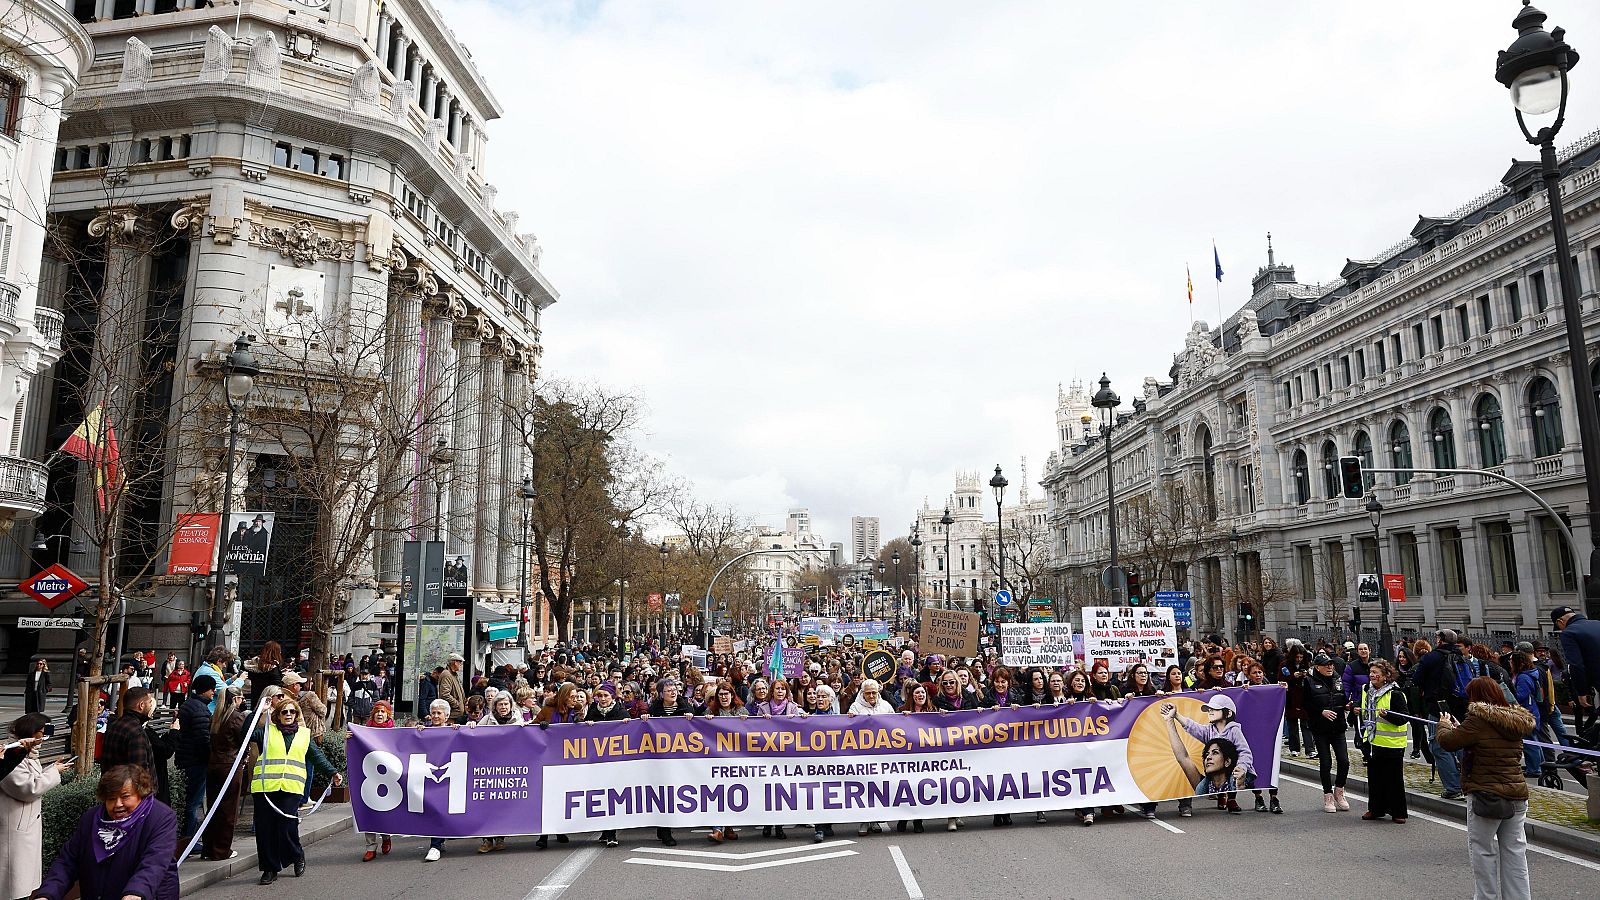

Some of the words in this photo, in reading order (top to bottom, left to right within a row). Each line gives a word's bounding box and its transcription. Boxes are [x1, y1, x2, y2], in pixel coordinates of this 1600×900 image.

[36, 581, 66, 591] Metro
[939, 612, 952, 620] QUE
[21, 619, 42, 627] Banco
[44, 619, 53, 627] de
[55, 620, 80, 628] España
[931, 619, 967, 631] EPSTEIN
[1096, 620, 1108, 629] LA
[1139, 617, 1173, 629] MUNDIAL
[1001, 626, 1031, 636] HOMBRES
[1044, 626, 1069, 636] MANDO
[1089, 630, 1110, 638] VIOLA
[1139, 629, 1165, 637] ASESINA
[935, 636, 965, 650] PORNO
[1100, 639, 1130, 647] MUJERES
[1138, 638, 1166, 647] MENORES
[1003, 645, 1032, 654] PUTEROS
[1040, 645, 1073, 654] ACOSANDO
[1018, 655, 1057, 665] VIOLANDO
[563, 738, 587, 759] NI
[593, 732, 711, 757] VELADAS,
[716, 732, 740, 752] NI
[746, 728, 913, 752] EXPLOTADAS,
[919, 728, 942, 748] NI
[948, 715, 1110, 746] PROSTITUIDAS
[473, 766, 529, 776] MOVIMIENTO
[711, 765, 767, 778] FRENTE
[770, 765, 781, 777] A
[784, 765, 804, 777] LA
[807, 762, 878, 776] BARBARIE
[881, 758, 971, 775] PATRIARCAL,
[360, 750, 468, 814] 8M
[473, 777, 528, 789] FEMINISTA
[472, 791, 485, 801] DE
[489, 790, 528, 800] MADRID
[564, 783, 749, 820] FEMINISMO
[764, 766, 1116, 812] INTERNACIONALISTA
